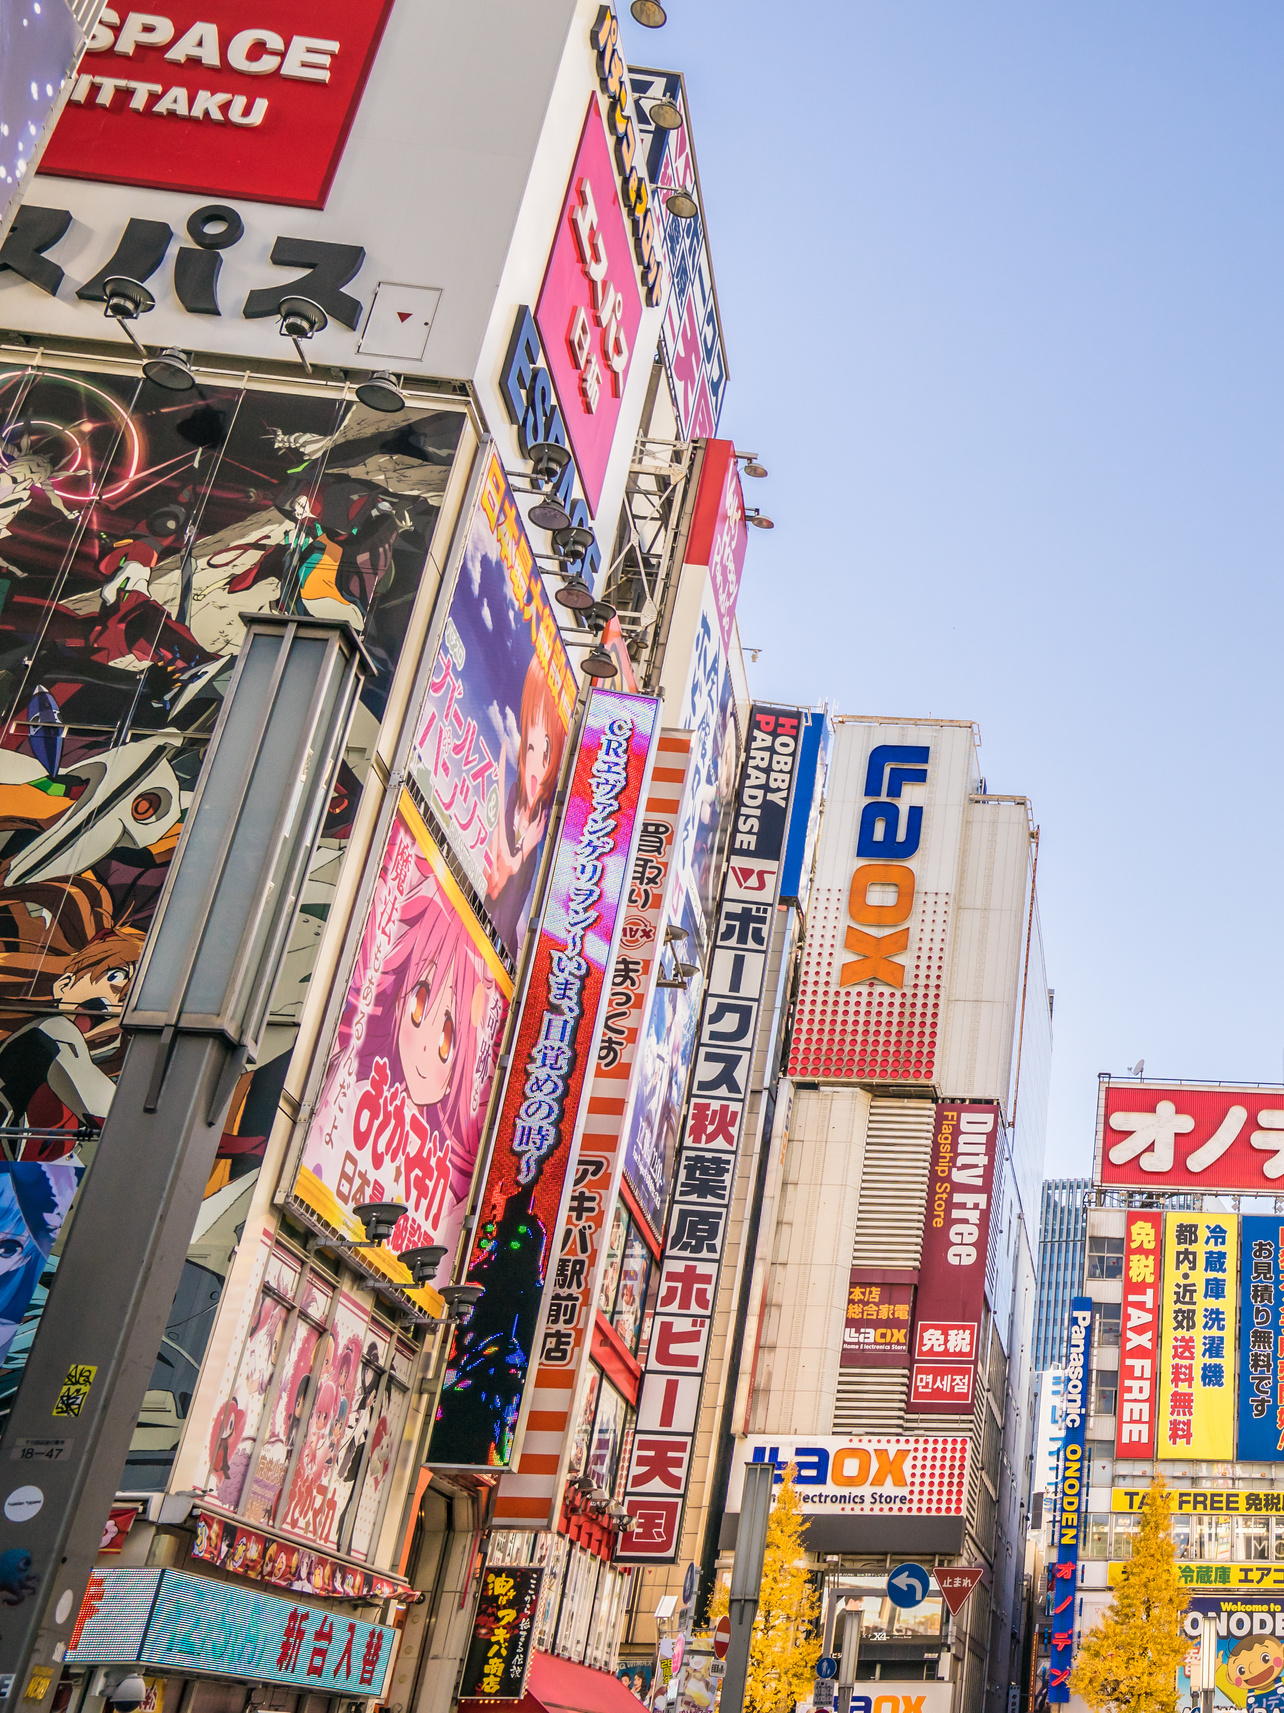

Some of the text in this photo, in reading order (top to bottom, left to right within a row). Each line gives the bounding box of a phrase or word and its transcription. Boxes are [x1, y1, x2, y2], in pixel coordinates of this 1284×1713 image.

[70, 73, 269, 127] ITTAKU
[564, 305, 602, 416] 日拓
[734, 714, 775, 851] PARADISE
[774, 716, 799, 808] HOBBY
[628, 820, 672, 909] 買取り
[596, 956, 644, 1069] まっくす
[932, 1111, 957, 1228] Flagship Store
[947, 1112, 995, 1266] Duty Free
[539, 1157, 605, 1364] アキバ駅前店
[849, 1286, 881, 1303] 本店
[1128, 1220, 1157, 1285] 免税
[846, 1303, 910, 1320] 総合家電
[921, 1328, 971, 1353] 免税
[1168, 1222, 1200, 1447] 都内・近郊送料無料
[1200, 1224, 1229, 1389] 冷蔵庫 洗濯機
[1250, 1239, 1275, 1419] お見積り無料です
[916, 1373, 969, 1394] 면세점
[1066, 1310, 1092, 1429] Panasonic
[1122, 1288, 1155, 1445] TAX FREE
[870, 1491, 908, 1506] Store
[1060, 1443, 1083, 1546] ONODEN
[1178, 1492, 1240, 1511] FREE
[941, 1576, 973, 1589] 止まれ
[1177, 1565, 1231, 1585] 冷蔵庫
[1220, 1602, 1282, 1612] Welcome to
[276, 1606, 386, 1687] 新台入替
[1050, 1561, 1077, 1689] オノデン
